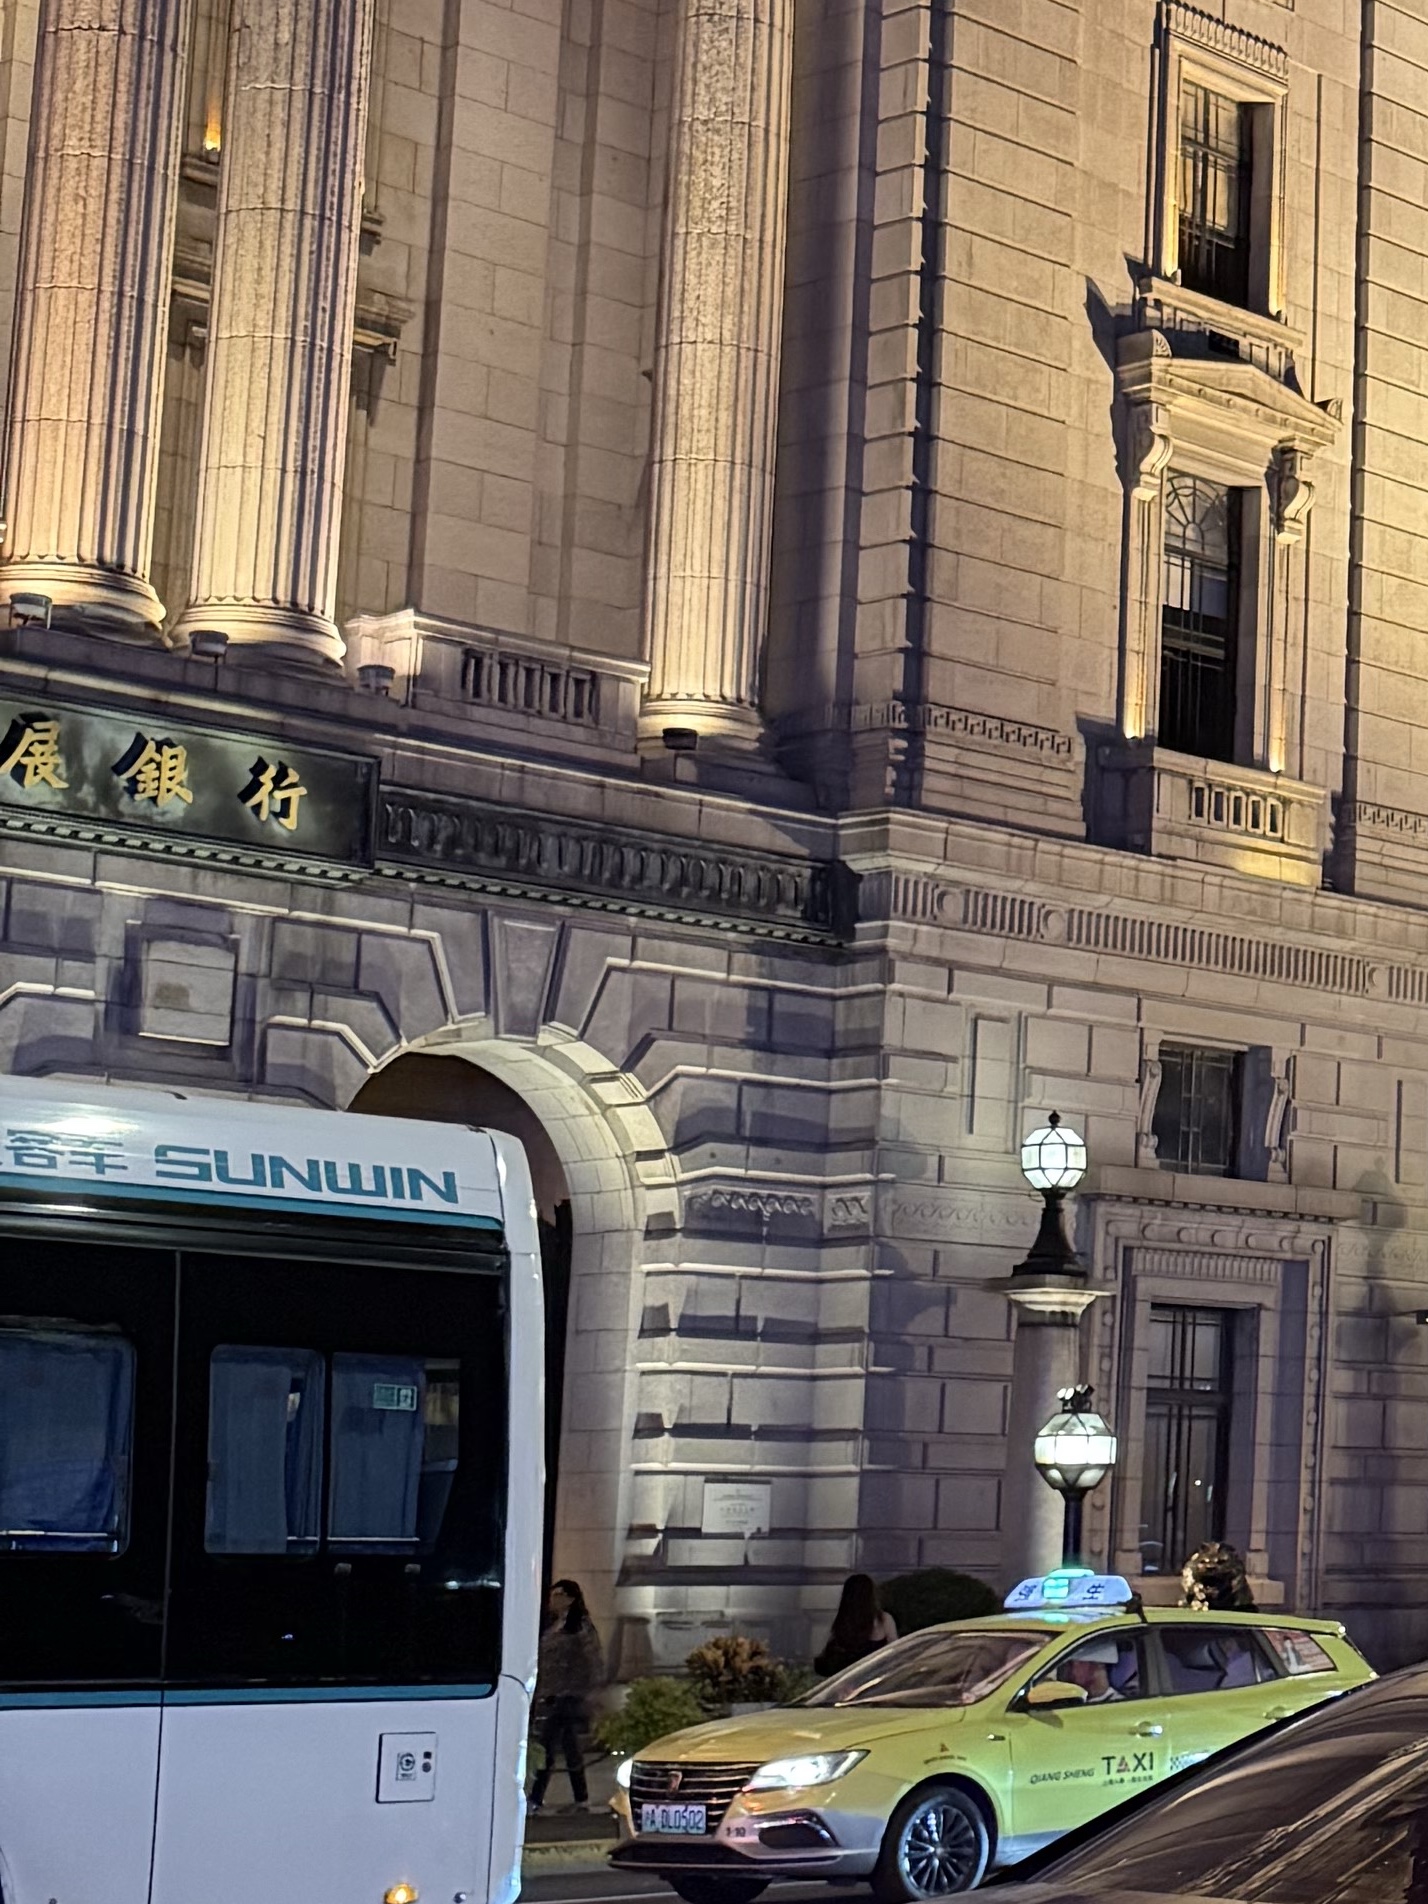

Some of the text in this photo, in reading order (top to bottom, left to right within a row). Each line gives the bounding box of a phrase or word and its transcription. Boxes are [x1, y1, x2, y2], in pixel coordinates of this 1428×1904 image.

[0, 719, 308, 831] 展銀行
[154, 1144, 459, 1204] SUNWIN
[1101, 1751, 1154, 1776] TAXI
